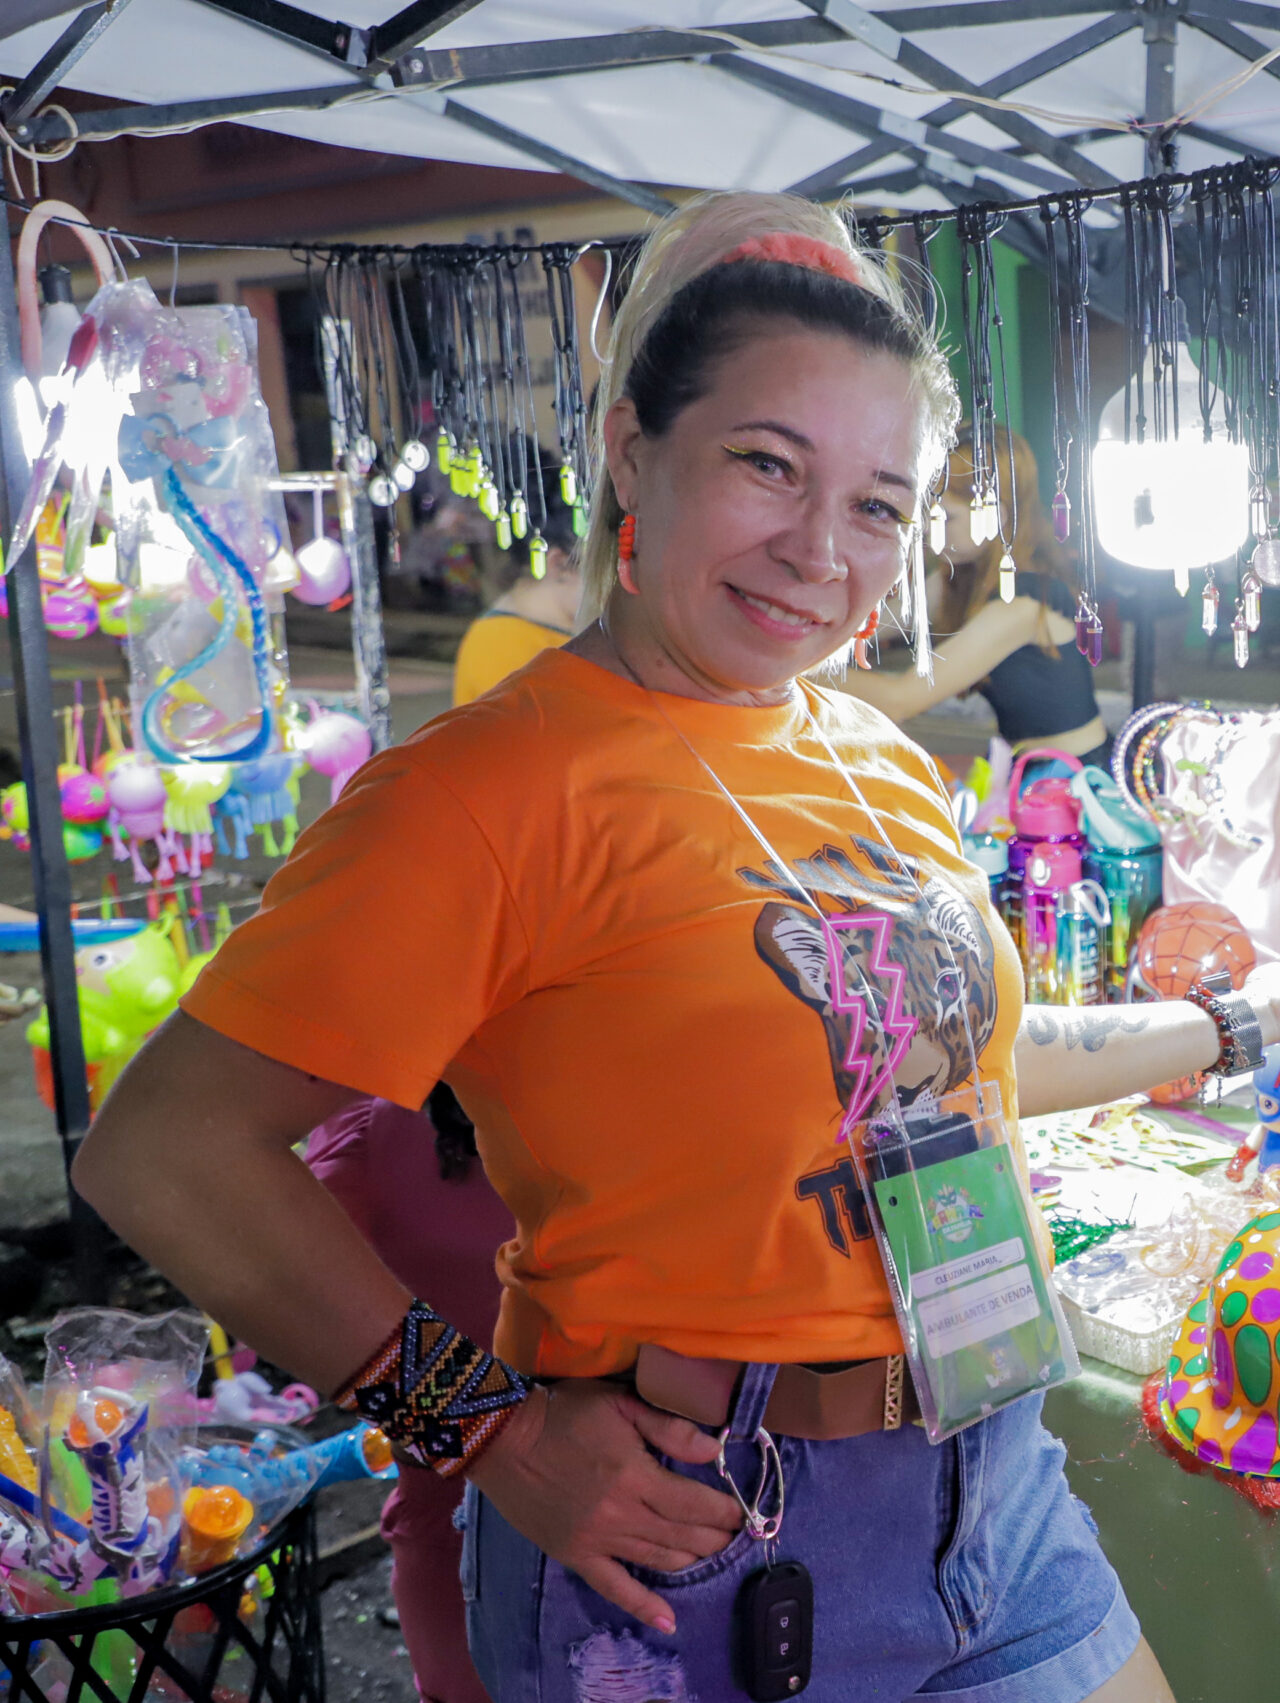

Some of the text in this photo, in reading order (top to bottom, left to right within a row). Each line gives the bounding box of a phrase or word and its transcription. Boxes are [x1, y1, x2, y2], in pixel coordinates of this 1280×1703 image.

[736, 834, 920, 918] WILD
[973, 1255, 998, 1271] MARIA
[927, 1285, 1033, 1336] AMBULANTE DE VENDA
